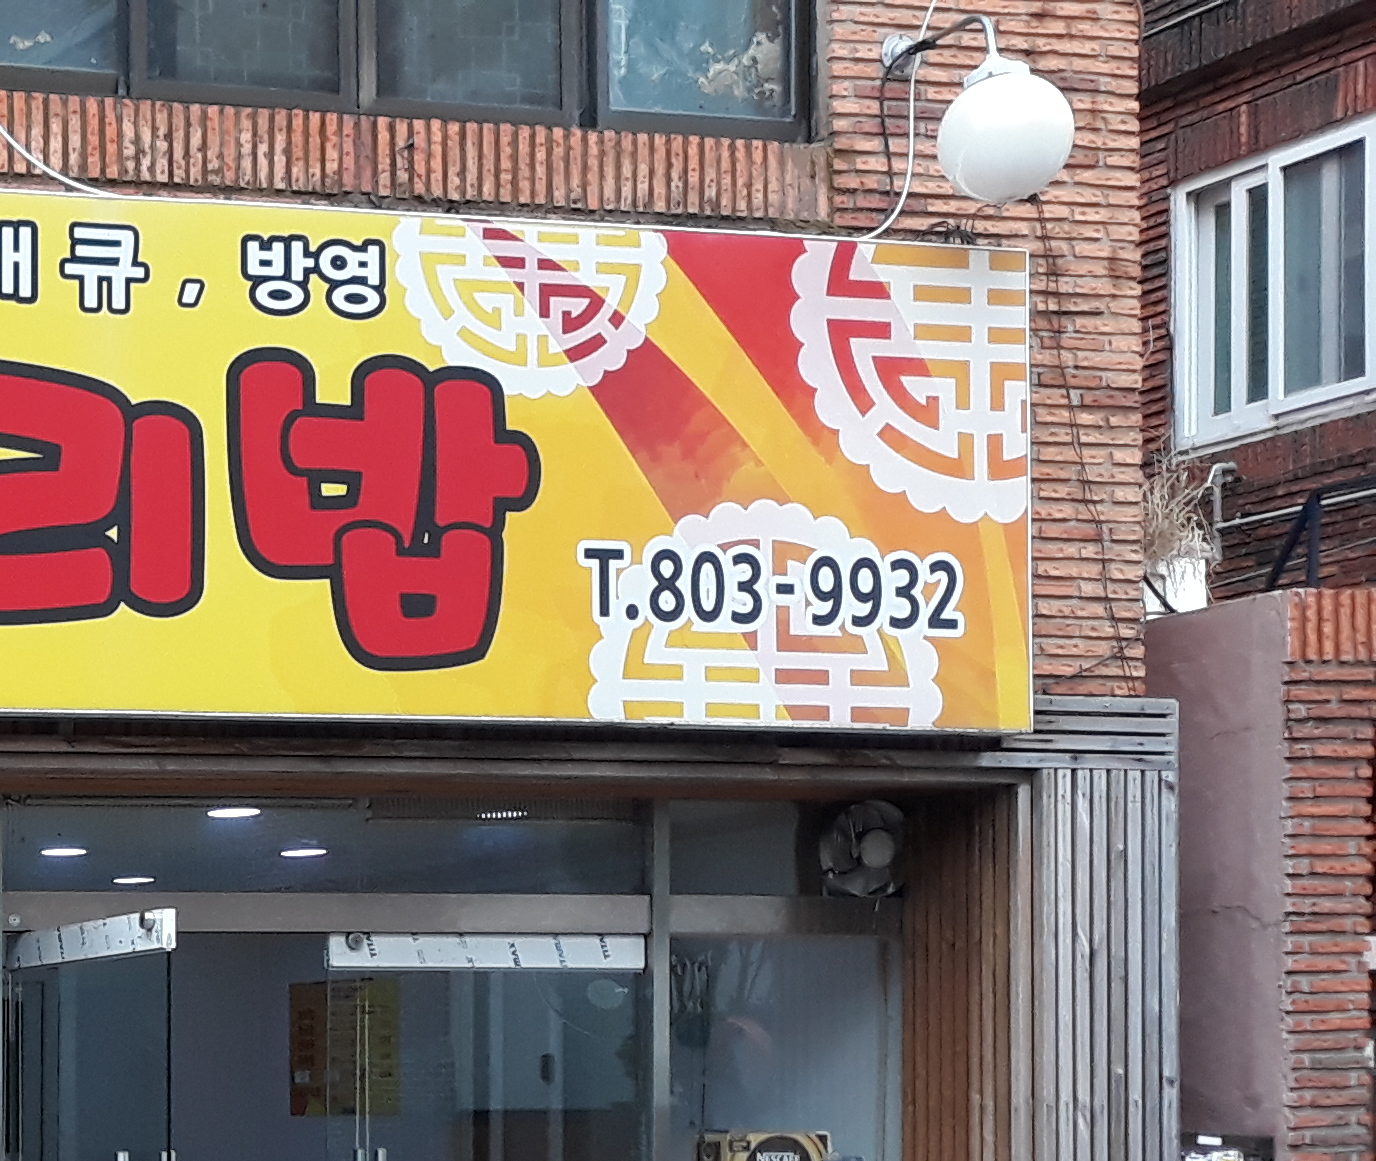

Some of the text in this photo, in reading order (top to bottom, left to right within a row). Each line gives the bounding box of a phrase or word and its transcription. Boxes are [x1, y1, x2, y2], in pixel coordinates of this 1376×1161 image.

[60, 222, 149, 314] 큐
[240, 235, 387, 314] 방영
[582, 540, 966, 636] T.803-9932
